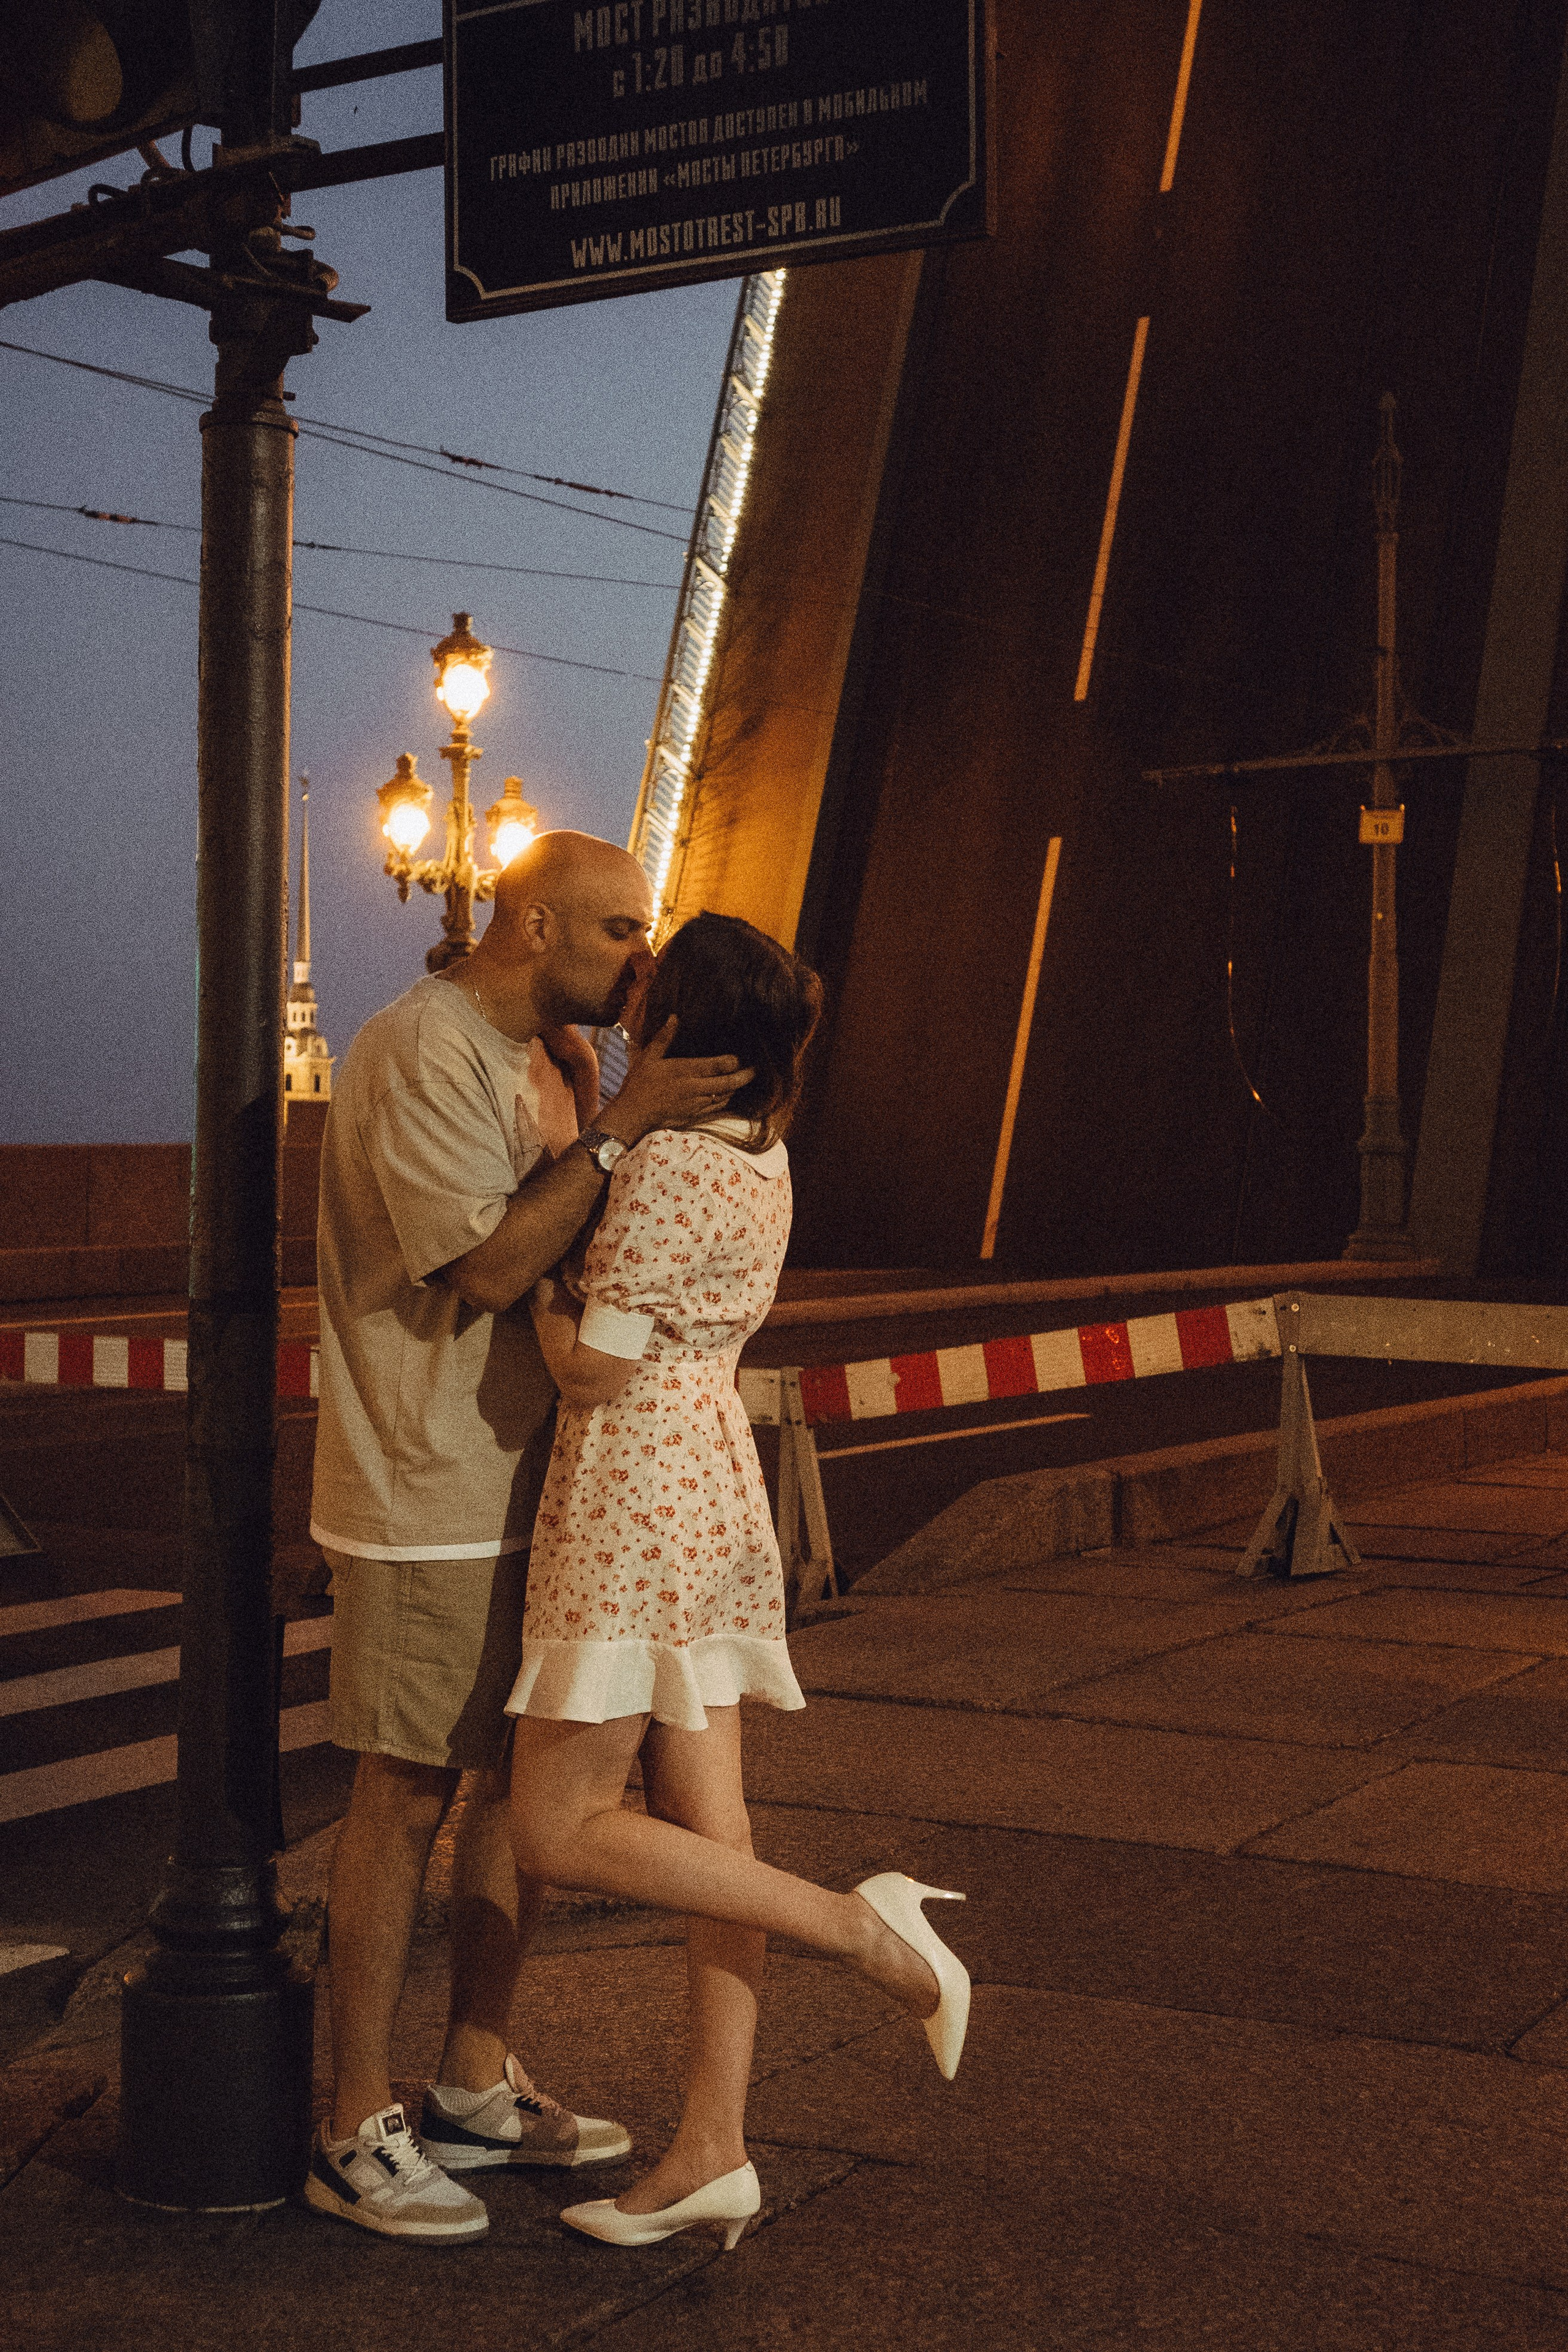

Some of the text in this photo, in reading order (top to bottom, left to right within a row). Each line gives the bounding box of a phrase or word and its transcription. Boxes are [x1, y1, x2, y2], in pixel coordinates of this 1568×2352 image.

[574, 0, 642, 53] МОСТ
[631, 44, 684, 94] 1:20
[692, 50, 723, 86] до
[732, 24, 788, 74] 4:50
[491, 78, 927, 182] ГРАФИК РАЗВОДКИ МОСТОВ ДОСТУПЕН В МОБИЛЬНОМ
[551, 134, 859, 210] ПРИЛОЖЕНИИ «МОСТЫ ПЕТЕРБУРГА»
[570, 195, 842, 269] WWW.MOSTOTREST-SPB.RU
[1373, 823, 1389, 837] 10
